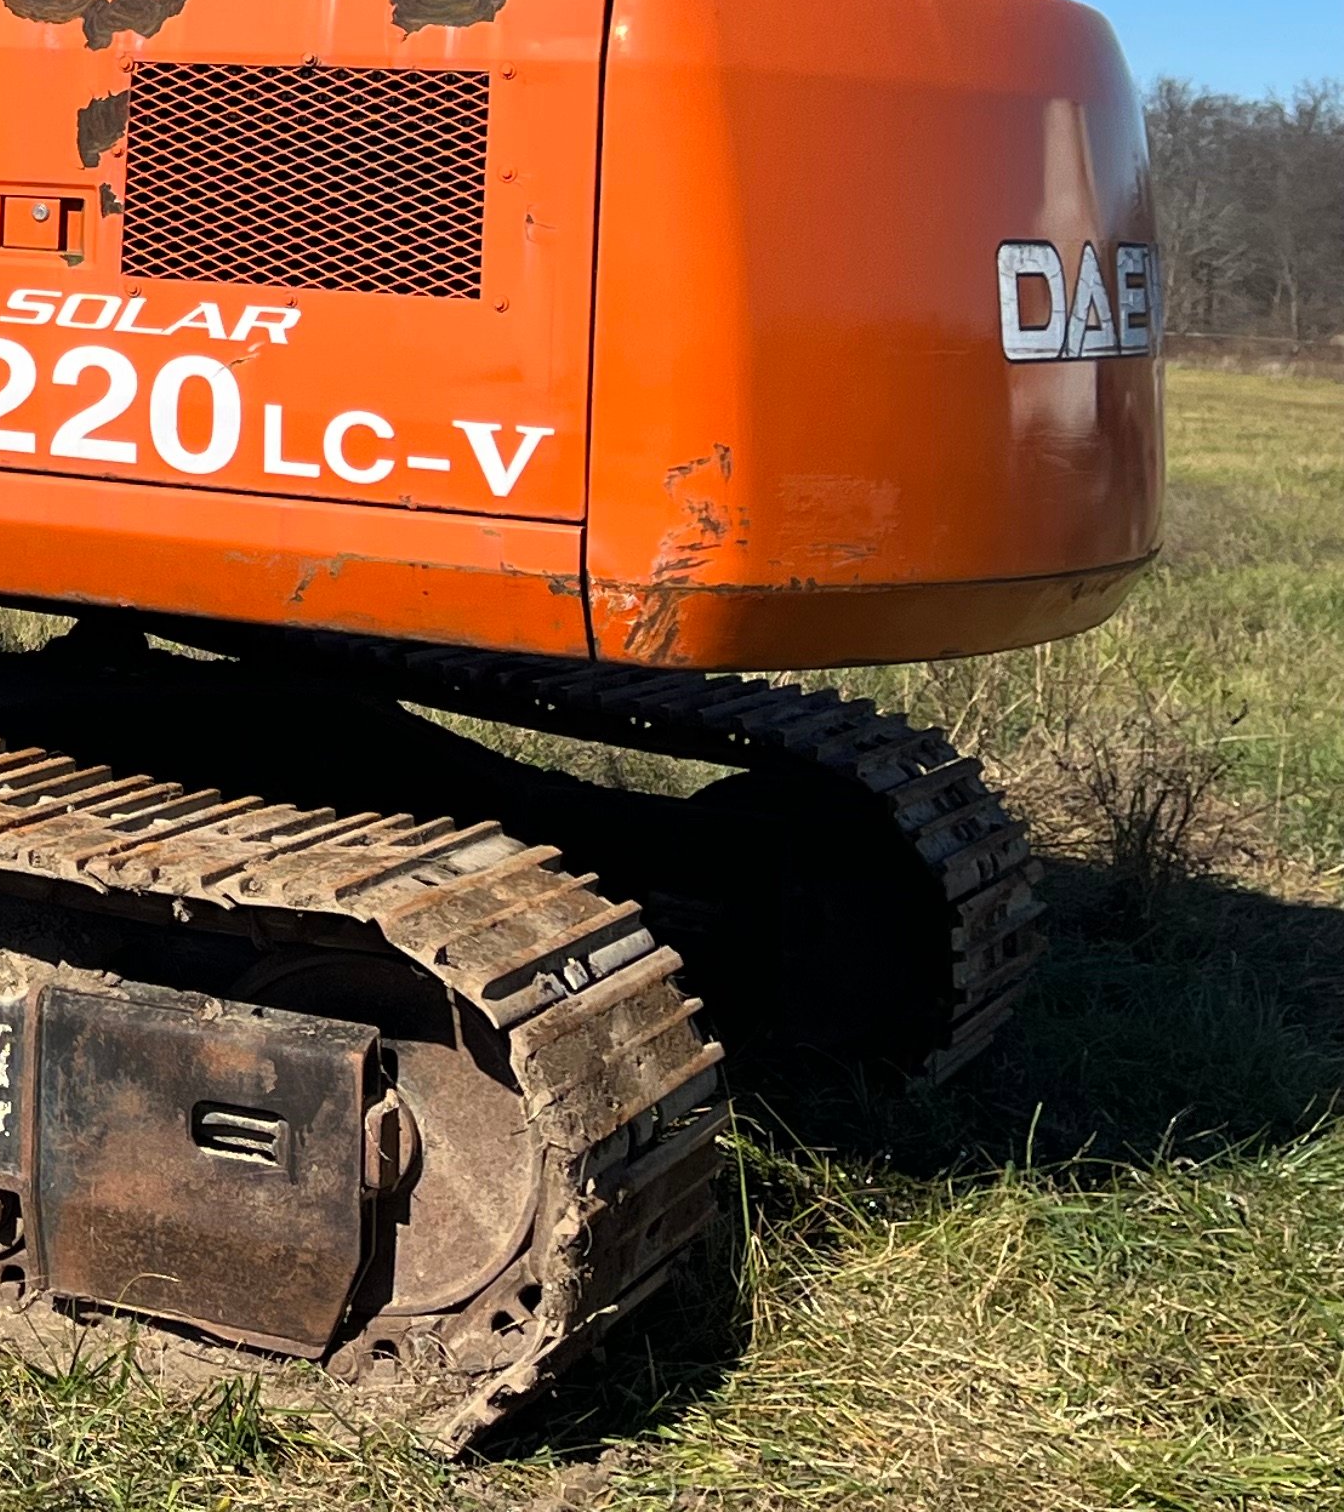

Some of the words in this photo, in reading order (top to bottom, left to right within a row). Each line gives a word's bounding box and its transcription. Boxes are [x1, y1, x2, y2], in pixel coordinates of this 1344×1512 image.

[0, 288, 302, 345] SOLAR
[996, 238, 1162, 364] DAE
[263, 403, 555, 497] LC-V
